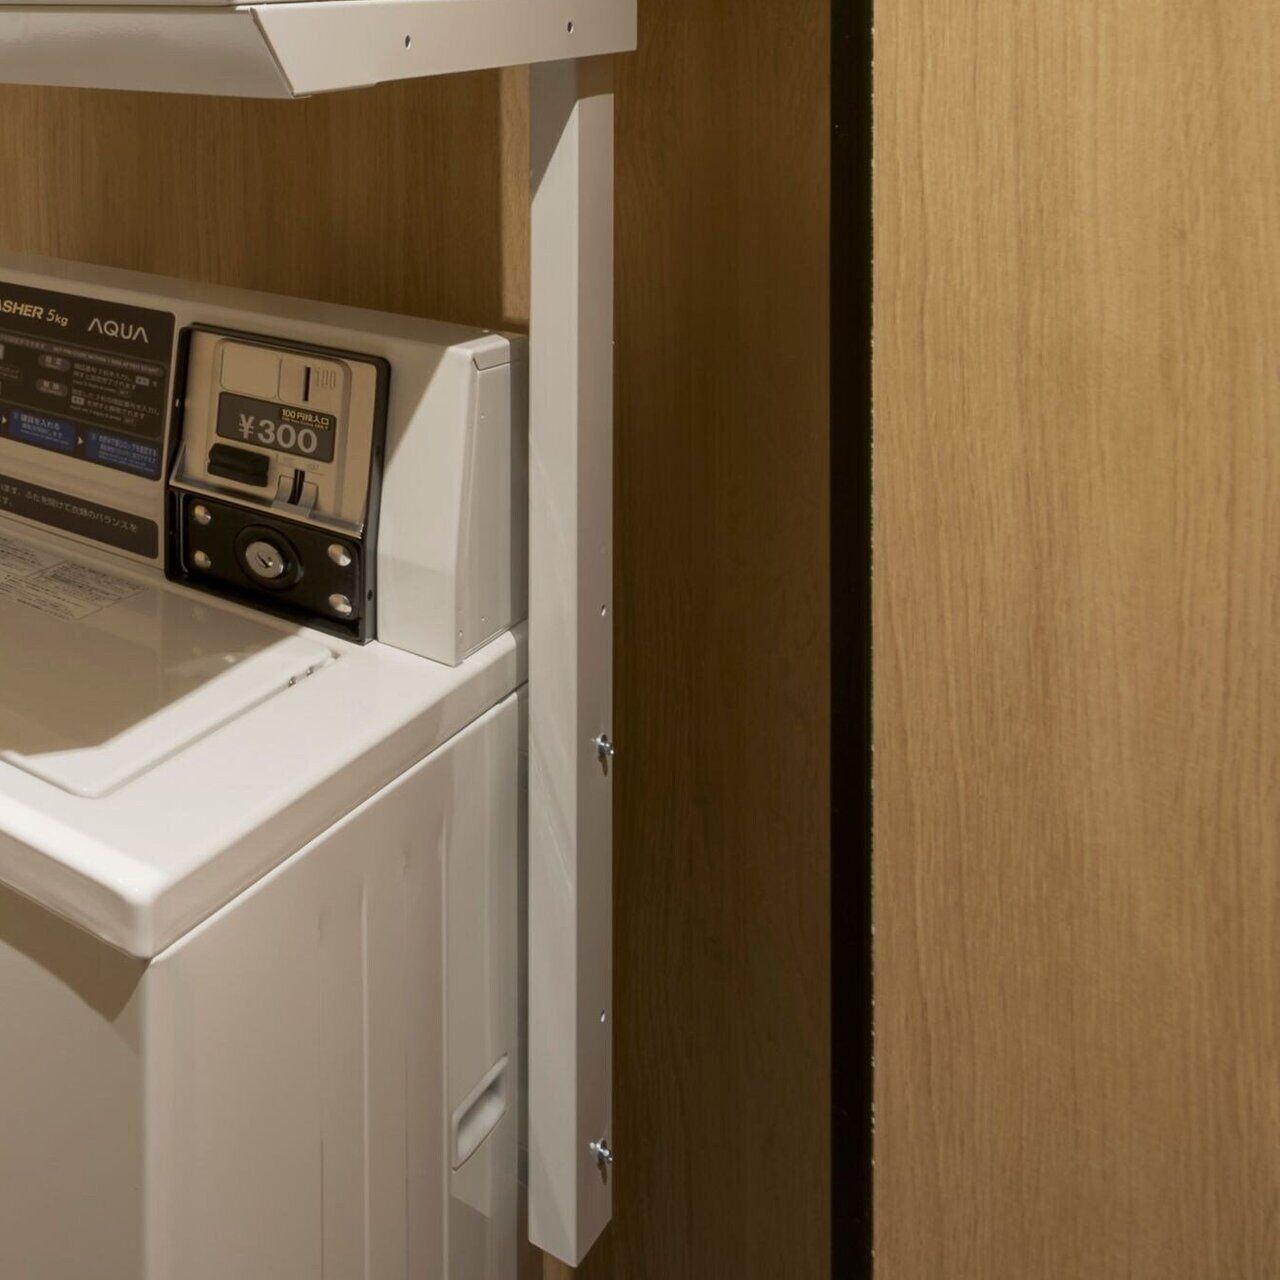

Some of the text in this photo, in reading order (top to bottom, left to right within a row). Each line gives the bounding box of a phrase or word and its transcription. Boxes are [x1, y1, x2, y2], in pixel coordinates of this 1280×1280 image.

[46, 308, 69, 328] 5kg
[87, 317, 150, 344] AQUA
[239, 413, 318, 455] ¥300
